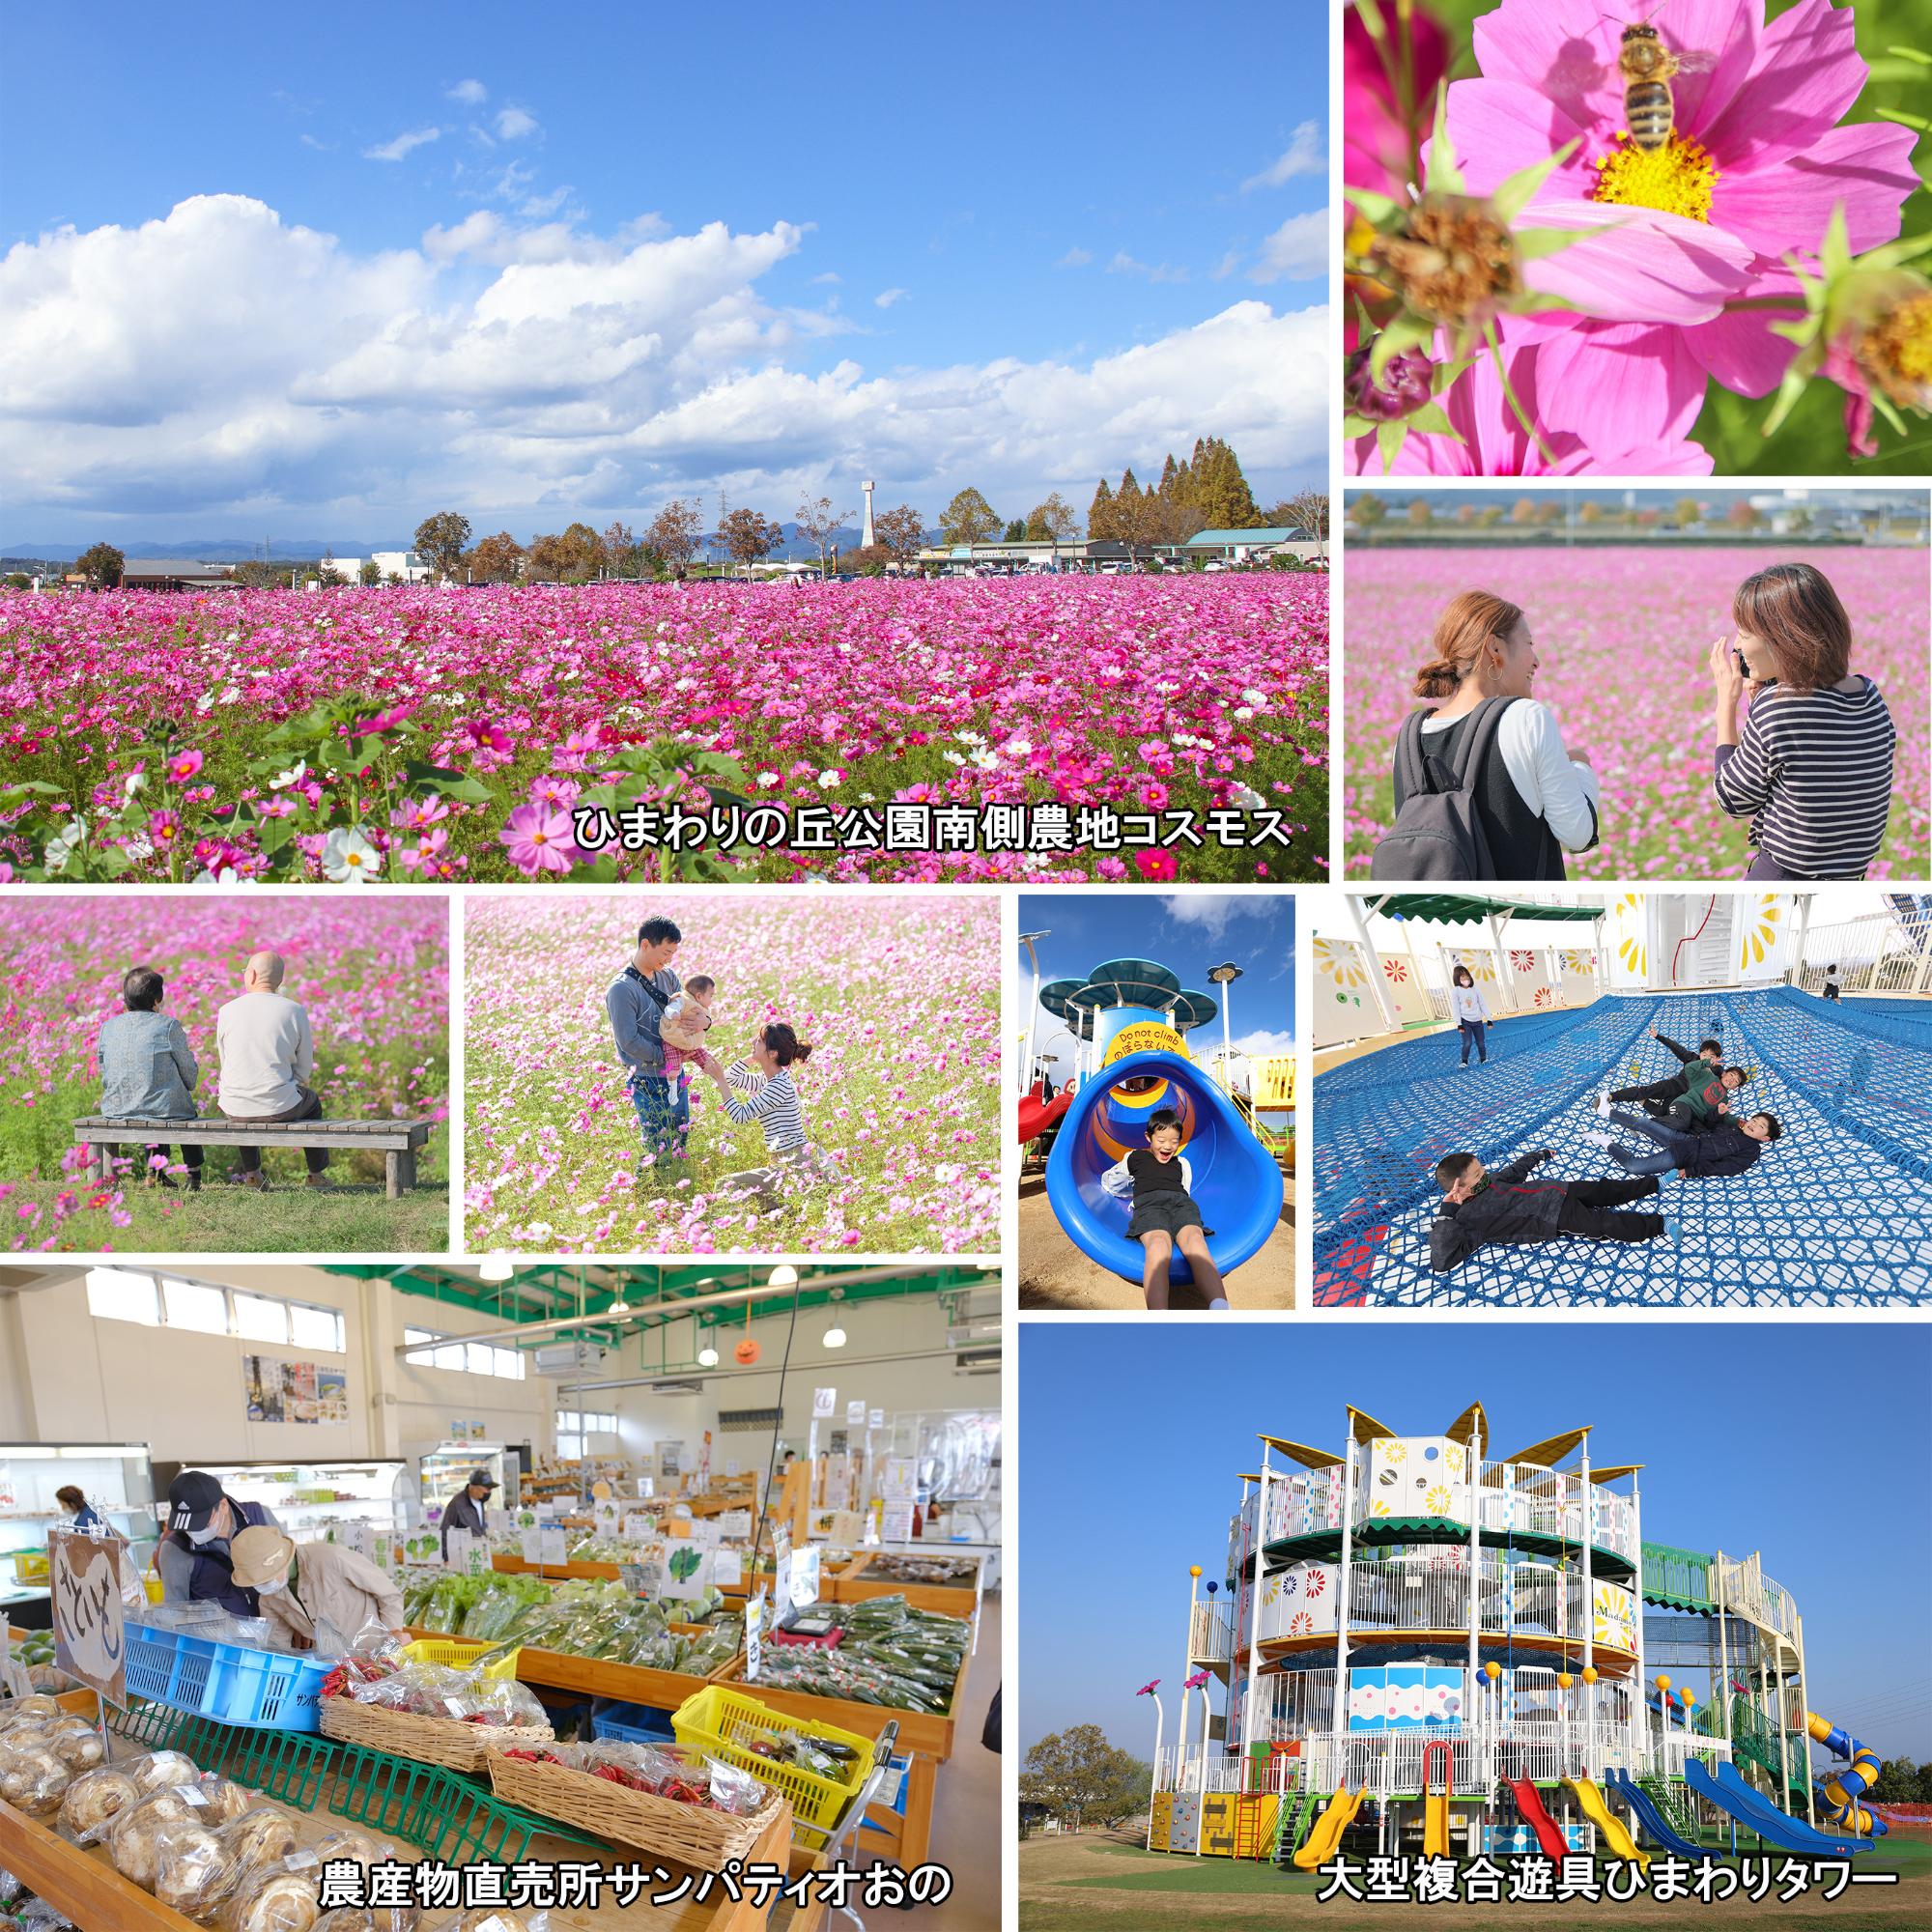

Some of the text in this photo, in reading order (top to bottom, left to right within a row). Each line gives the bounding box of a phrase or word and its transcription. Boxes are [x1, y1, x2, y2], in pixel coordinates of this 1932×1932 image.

[1120, 1029, 1179, 1046] Do not climb
